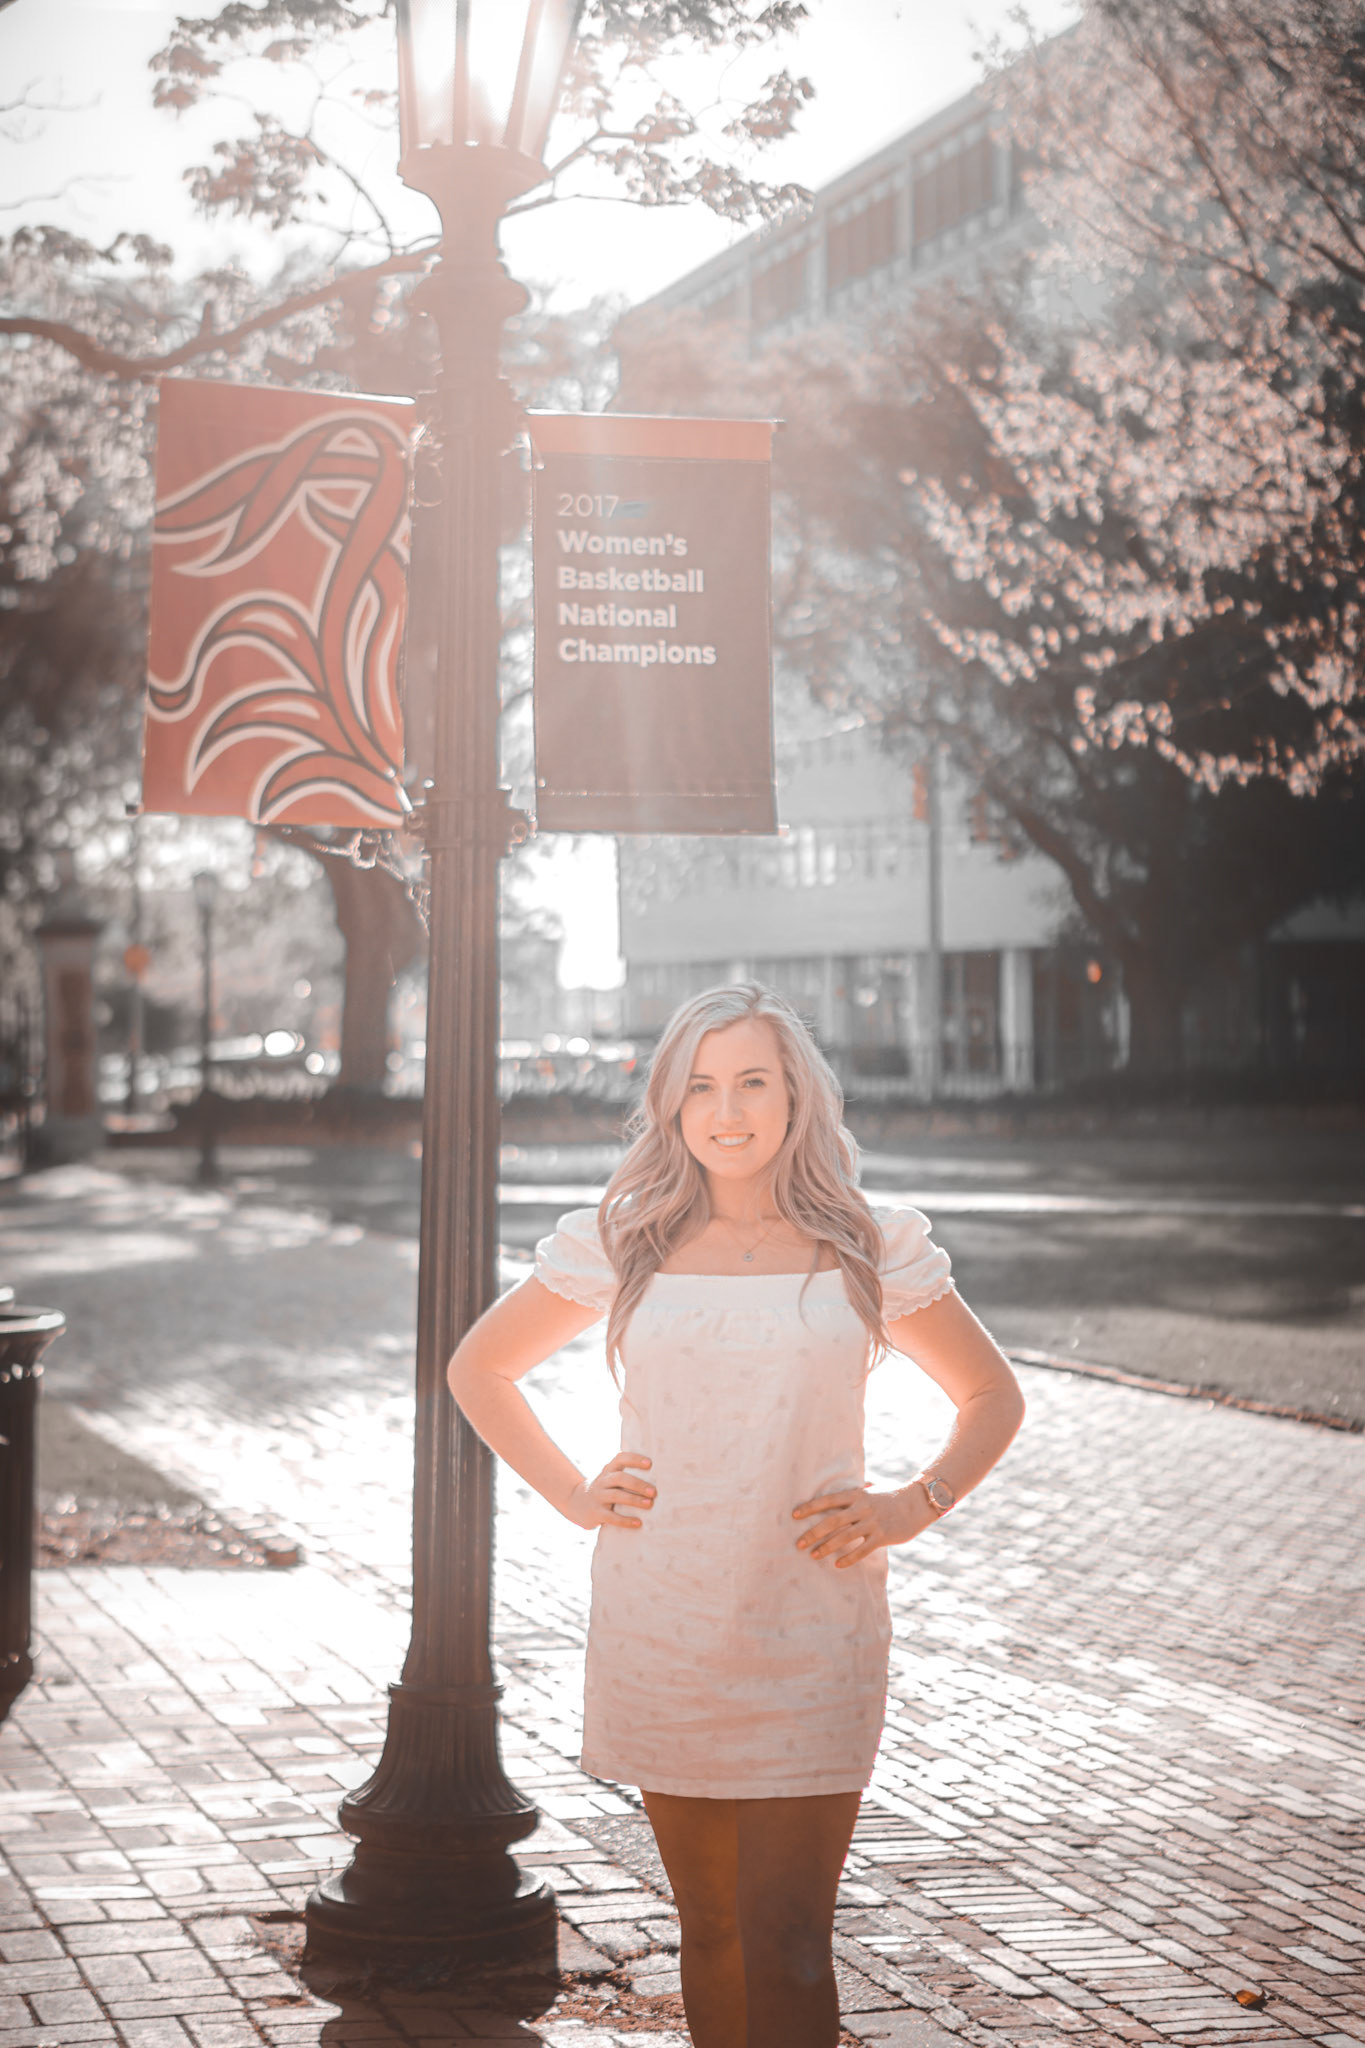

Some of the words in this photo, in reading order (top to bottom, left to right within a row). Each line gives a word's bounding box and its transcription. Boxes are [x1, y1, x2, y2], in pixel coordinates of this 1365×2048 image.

[558, 494, 619, 518] 2017
[557, 530, 688, 556] Women's
[558, 566, 704, 593] Basketball
[559, 602, 677, 628] National
[558, 638, 717, 668] Champions
